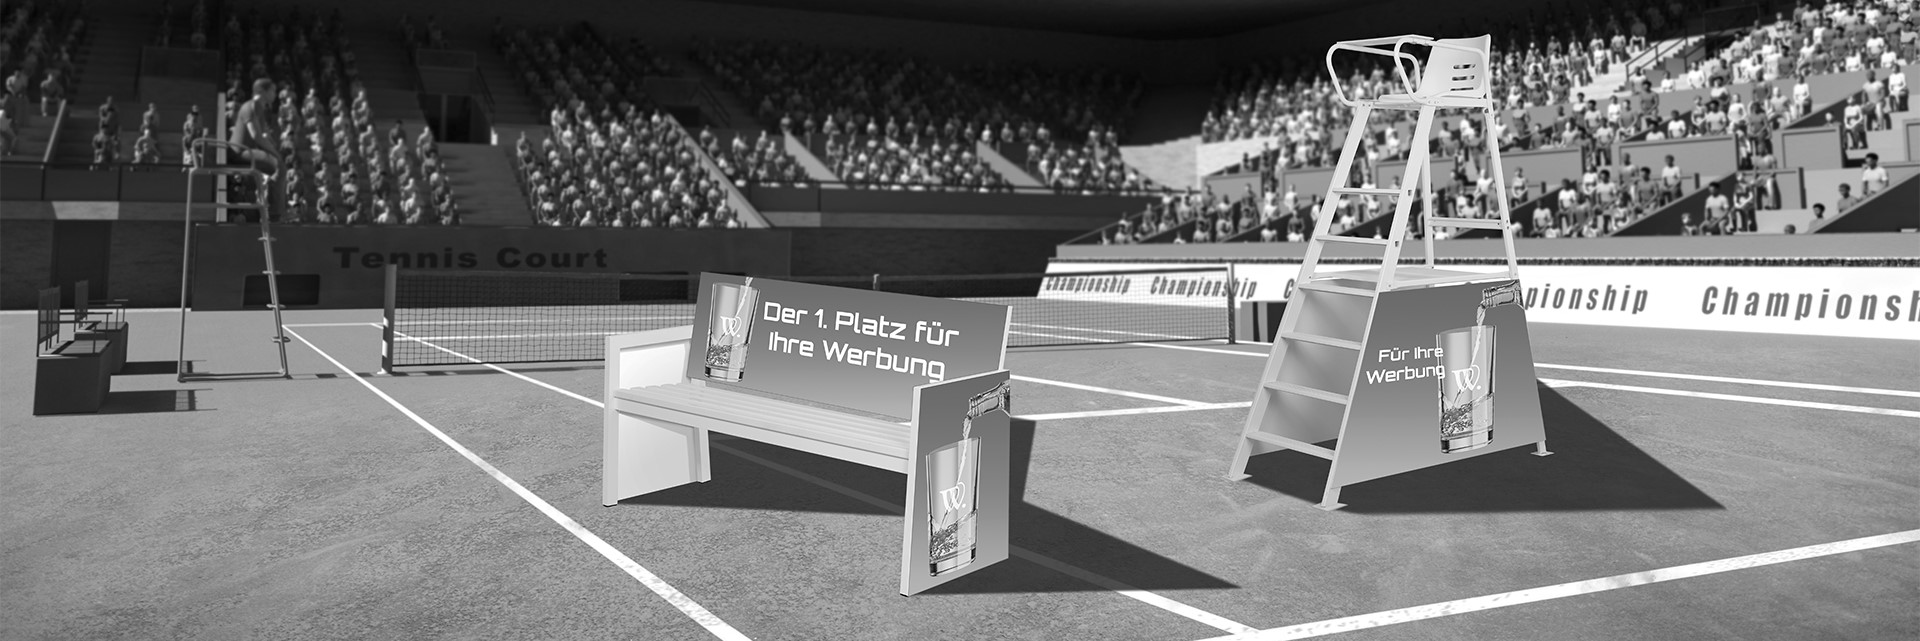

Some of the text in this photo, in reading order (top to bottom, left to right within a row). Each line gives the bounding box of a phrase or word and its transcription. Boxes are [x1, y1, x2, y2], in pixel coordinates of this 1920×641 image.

[332, 246, 608, 269] Tennis Court
[1524, 283, 1648, 314] pionship
[763, 301, 960, 347] Der 1. Platz für
[768, 331, 946, 383] Ihre Werbung
[1378, 346, 1444, 363] Für Ihre
[1366, 365, 1446, 385] Werbung
